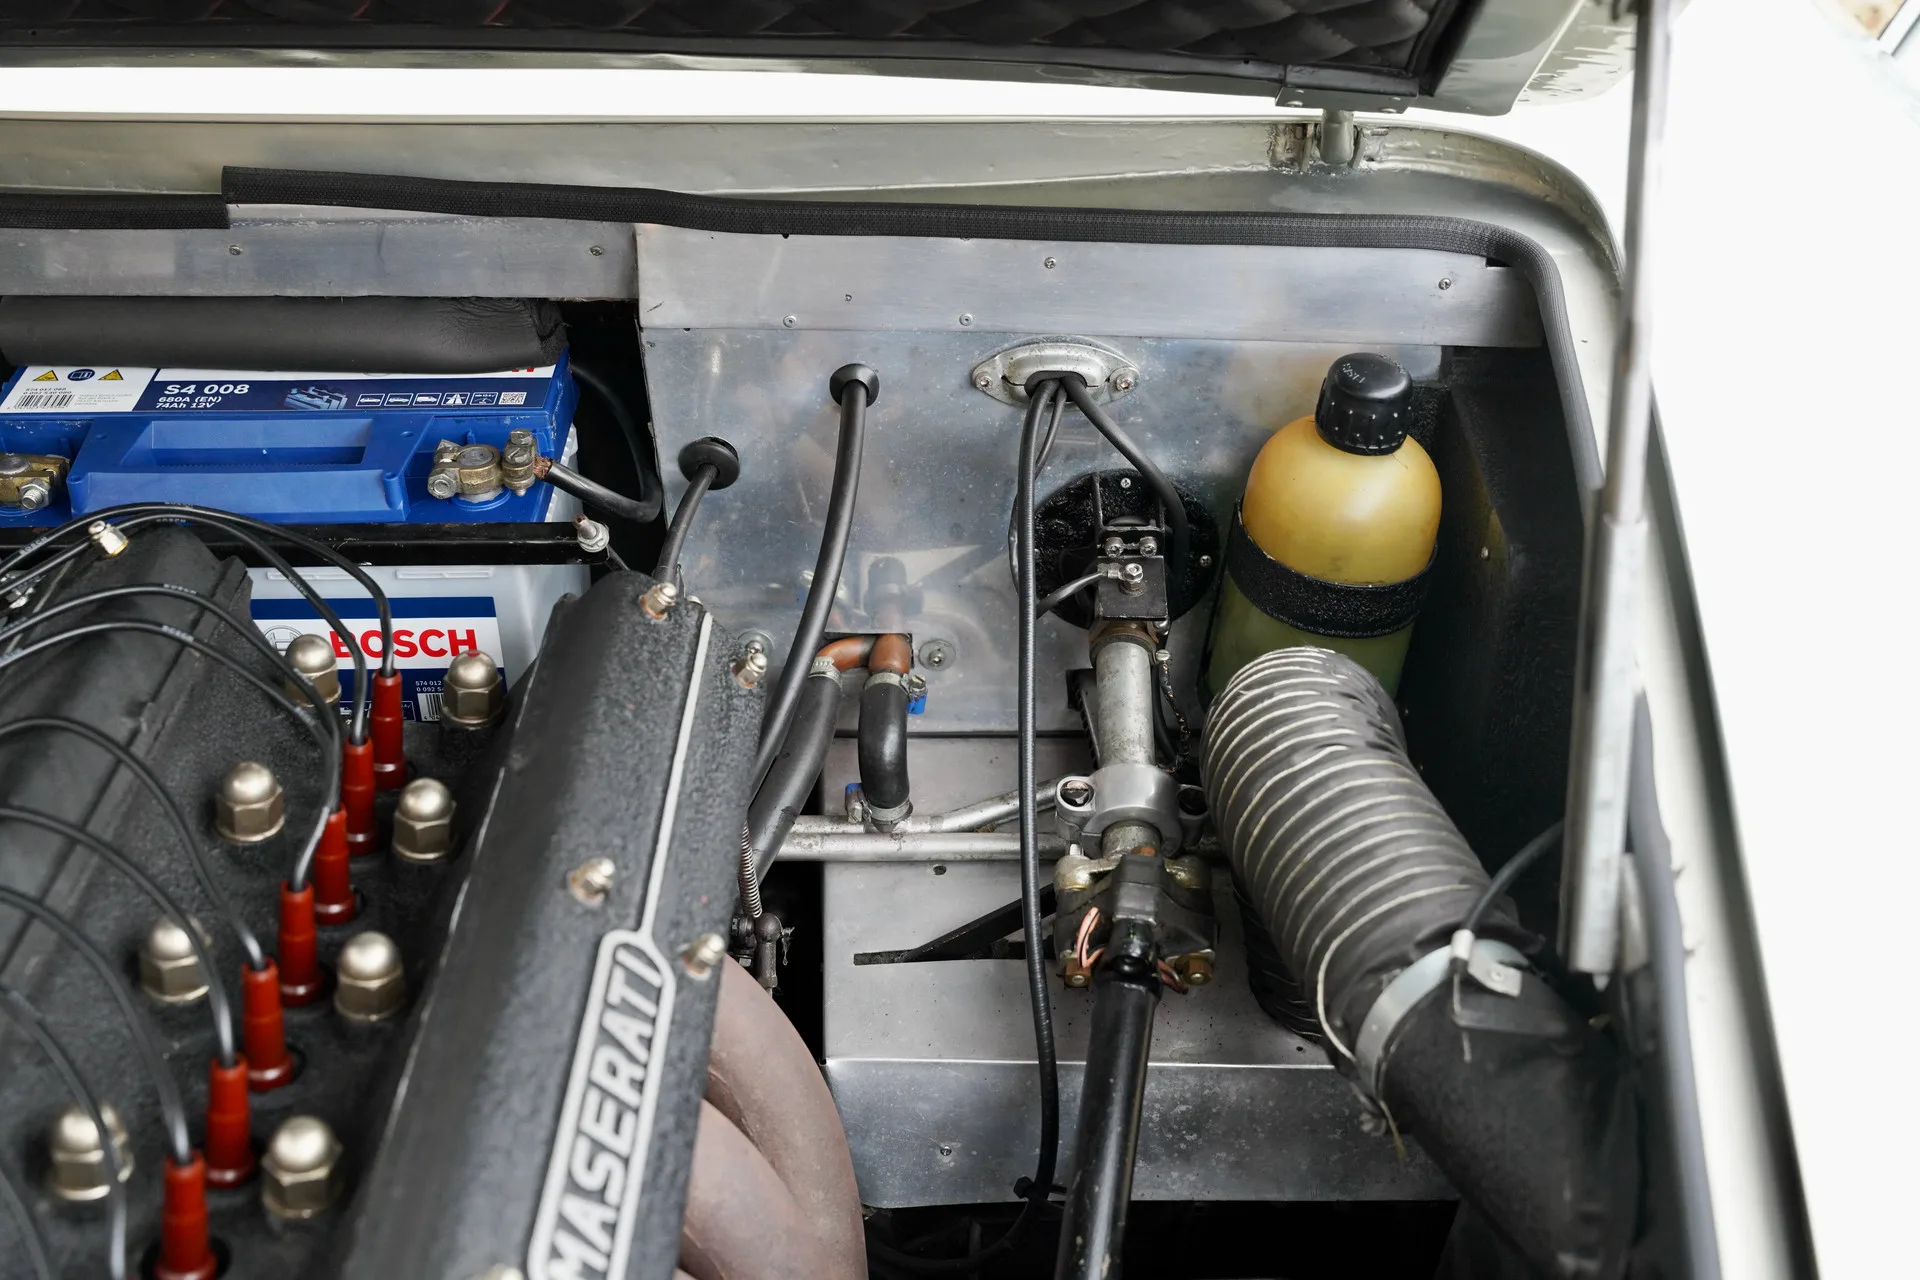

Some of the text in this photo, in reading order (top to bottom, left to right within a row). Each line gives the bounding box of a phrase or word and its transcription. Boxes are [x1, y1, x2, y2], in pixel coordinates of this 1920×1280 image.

[163, 384, 250, 395] S4 008
[195, 395, 222, 403] (EN)
[547, 947, 664, 1280] MASERATI
